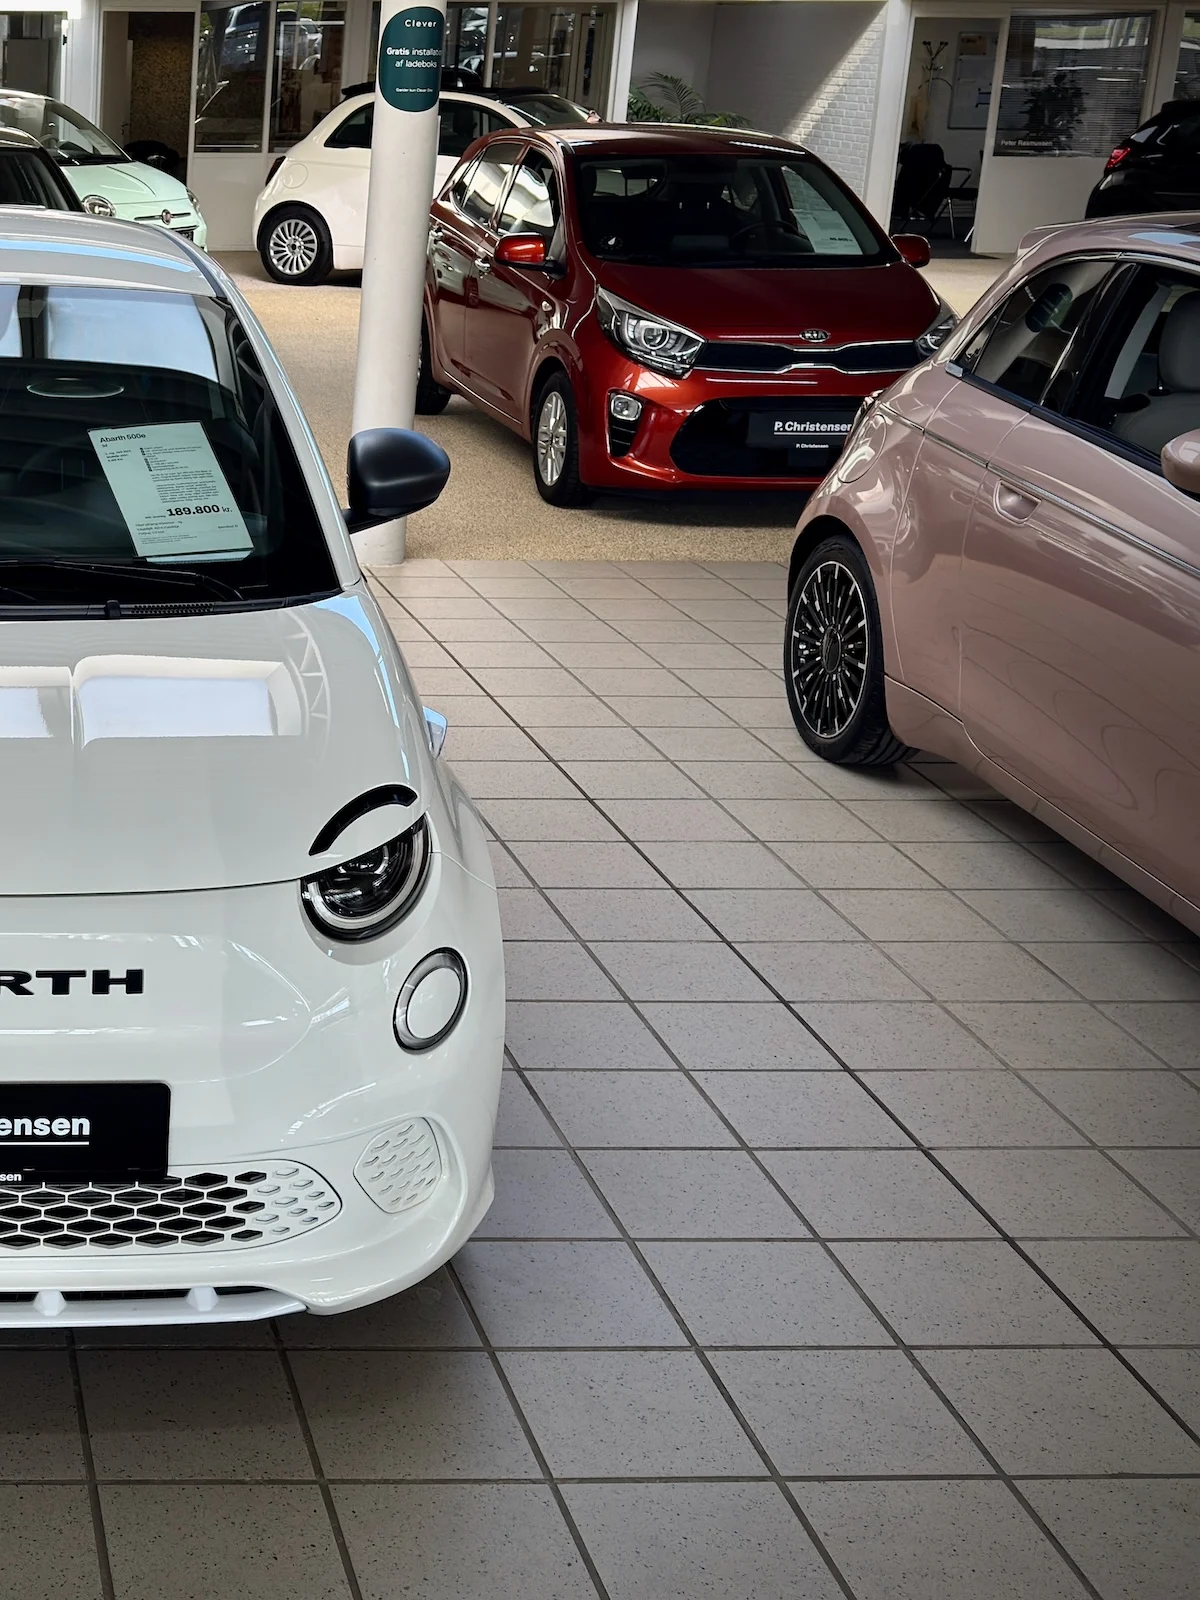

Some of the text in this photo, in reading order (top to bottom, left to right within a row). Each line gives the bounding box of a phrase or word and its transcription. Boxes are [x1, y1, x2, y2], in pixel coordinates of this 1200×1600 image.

[404, 20, 437, 28] Clever
[386, 47, 410, 56] Gratis
[395, 59, 437, 68] af ladeboks
[804, 331, 826, 339] KIA
[774, 420, 783, 432] P.
[100, 433, 146, 443] Abarth 500e
[166, 504, 220, 517] 189.800
